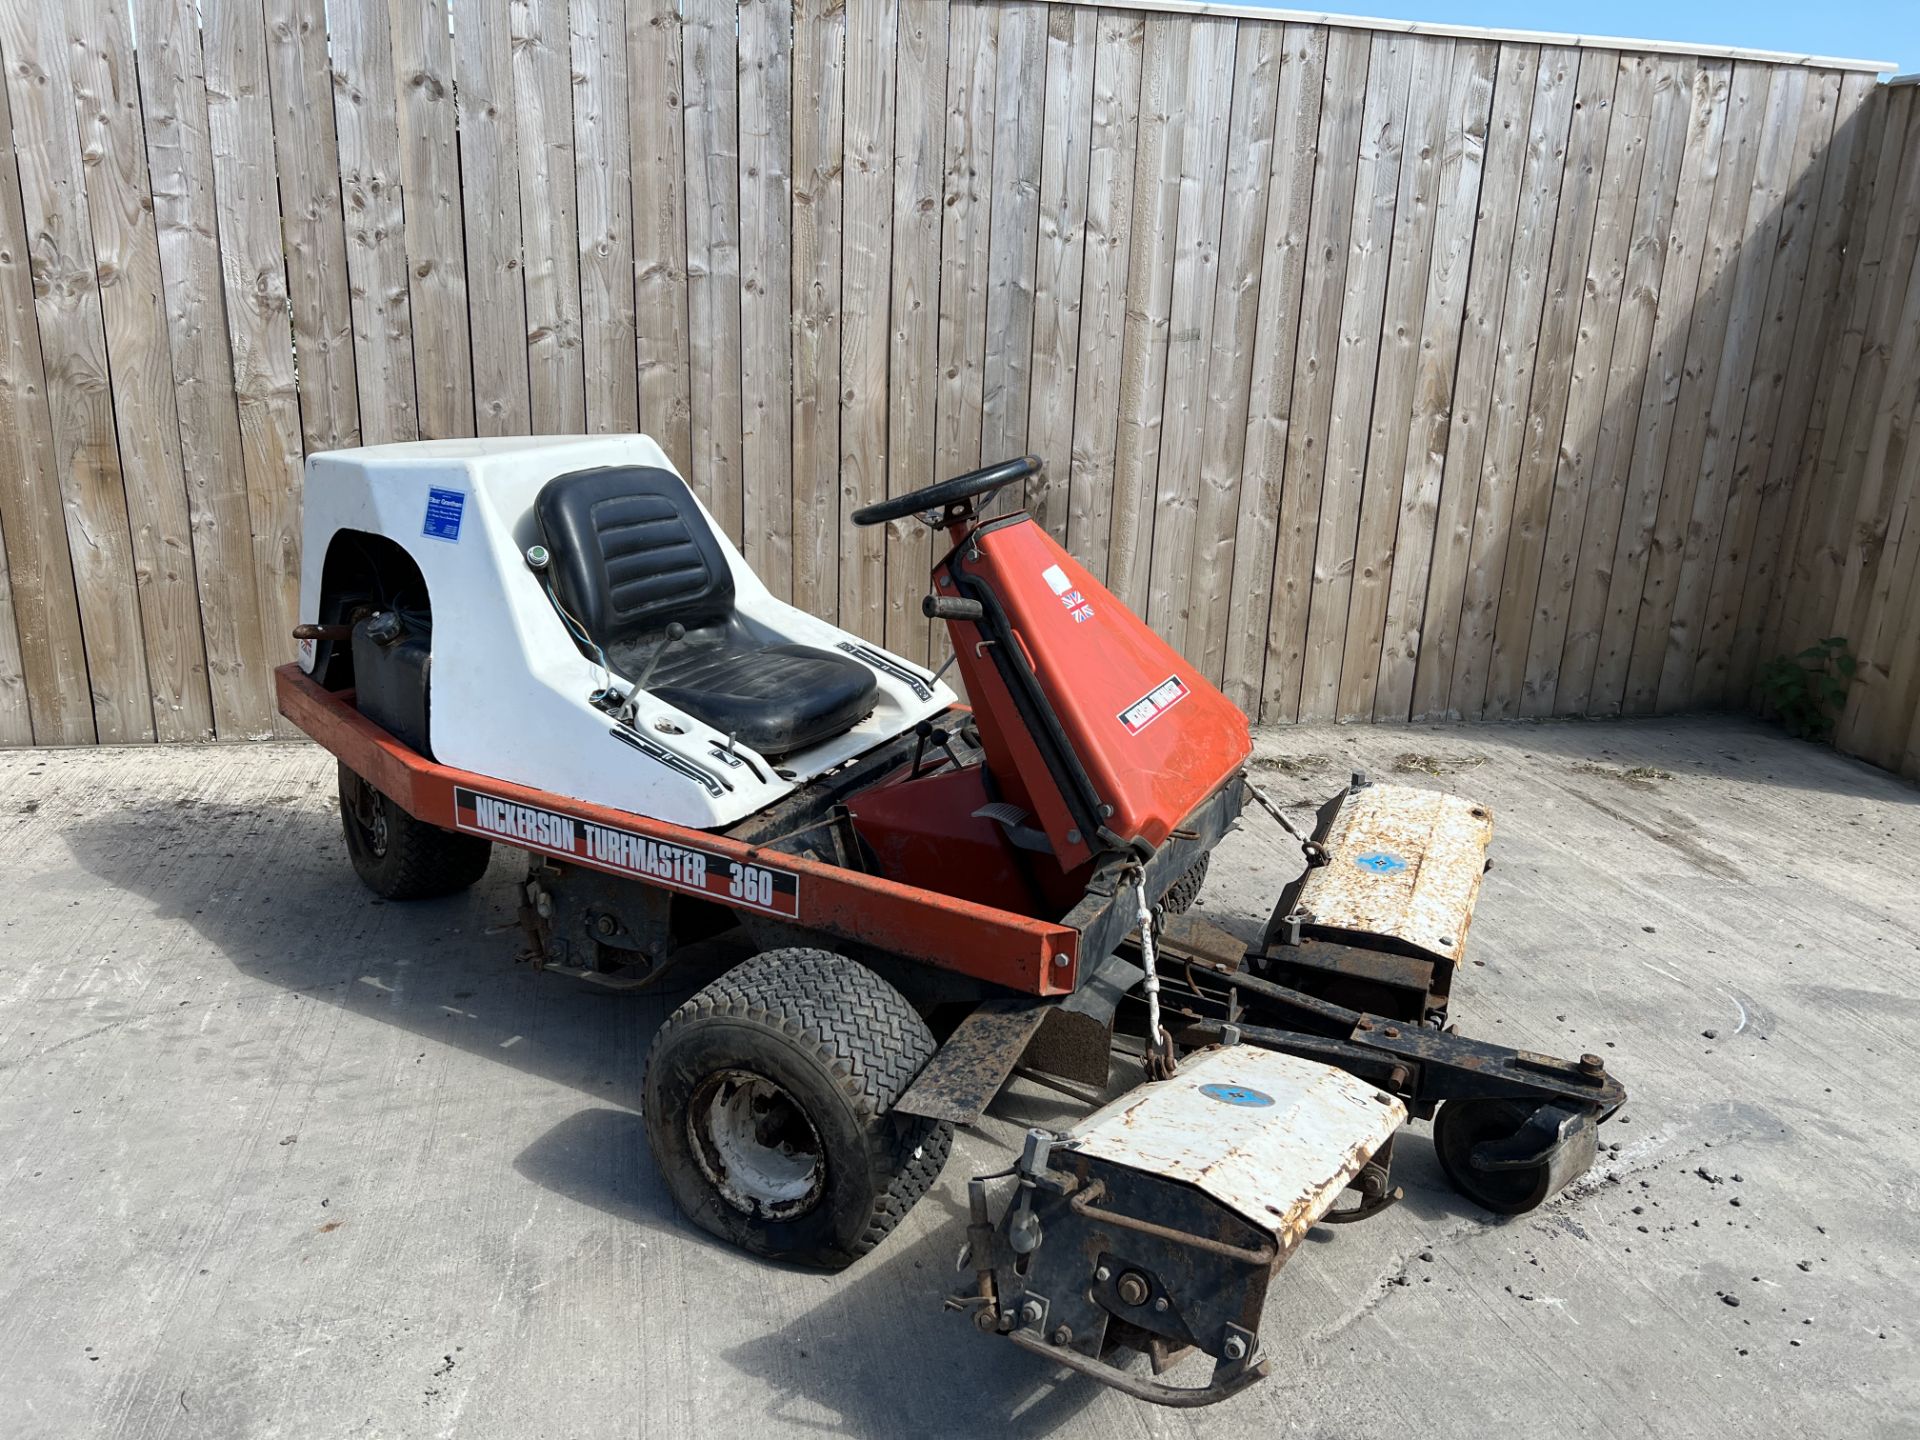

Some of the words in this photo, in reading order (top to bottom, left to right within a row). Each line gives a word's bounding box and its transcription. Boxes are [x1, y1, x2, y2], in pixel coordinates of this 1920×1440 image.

[475, 796, 576, 852] NICKERSON
[584, 824, 707, 889] TURFMASTER
[729, 862, 773, 907] 360
